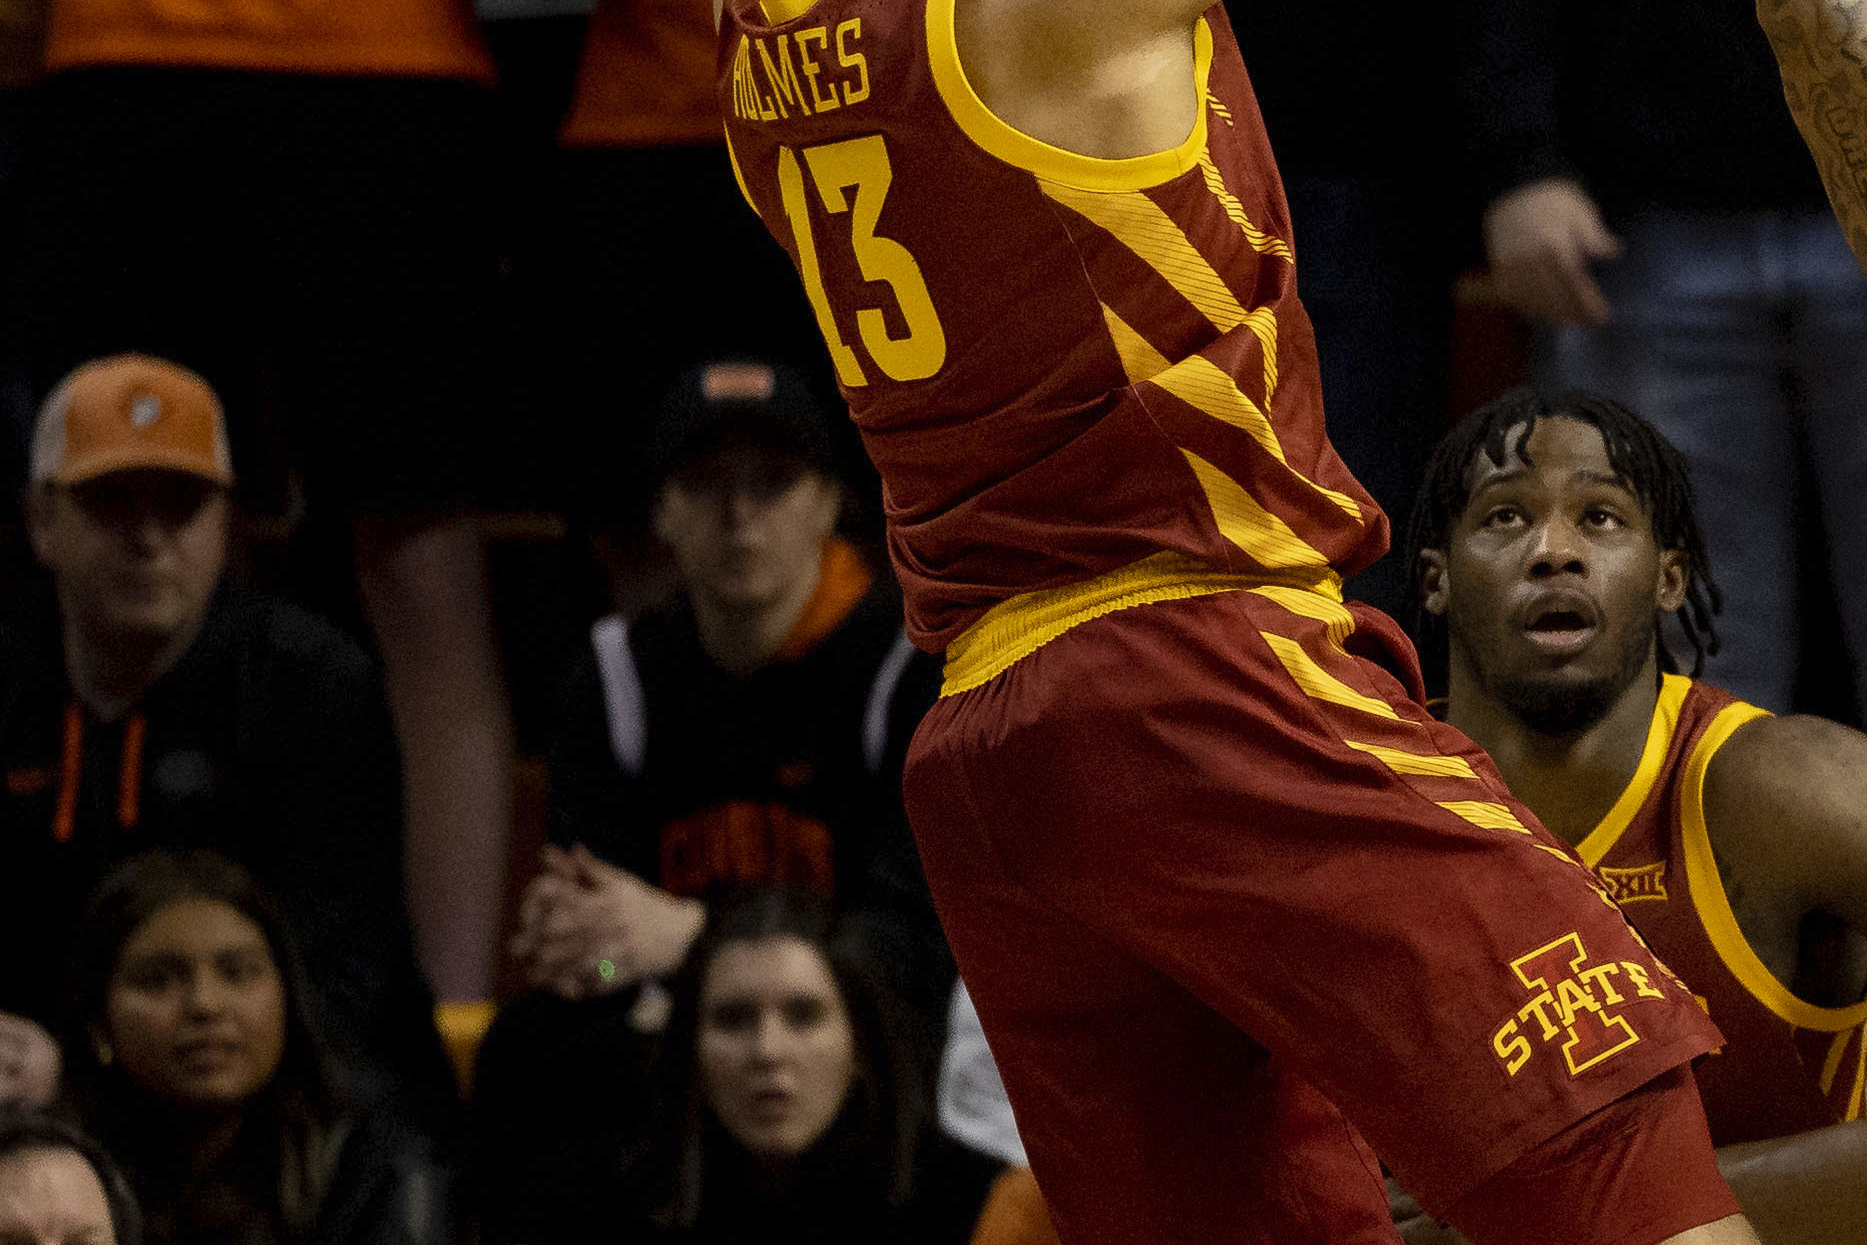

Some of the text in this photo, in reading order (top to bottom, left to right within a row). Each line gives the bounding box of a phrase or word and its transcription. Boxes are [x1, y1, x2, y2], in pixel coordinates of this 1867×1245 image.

[732, 16, 871, 123] HOLMES
[777, 133, 947, 388] 13
[1492, 960, 1666, 1077] STATE
